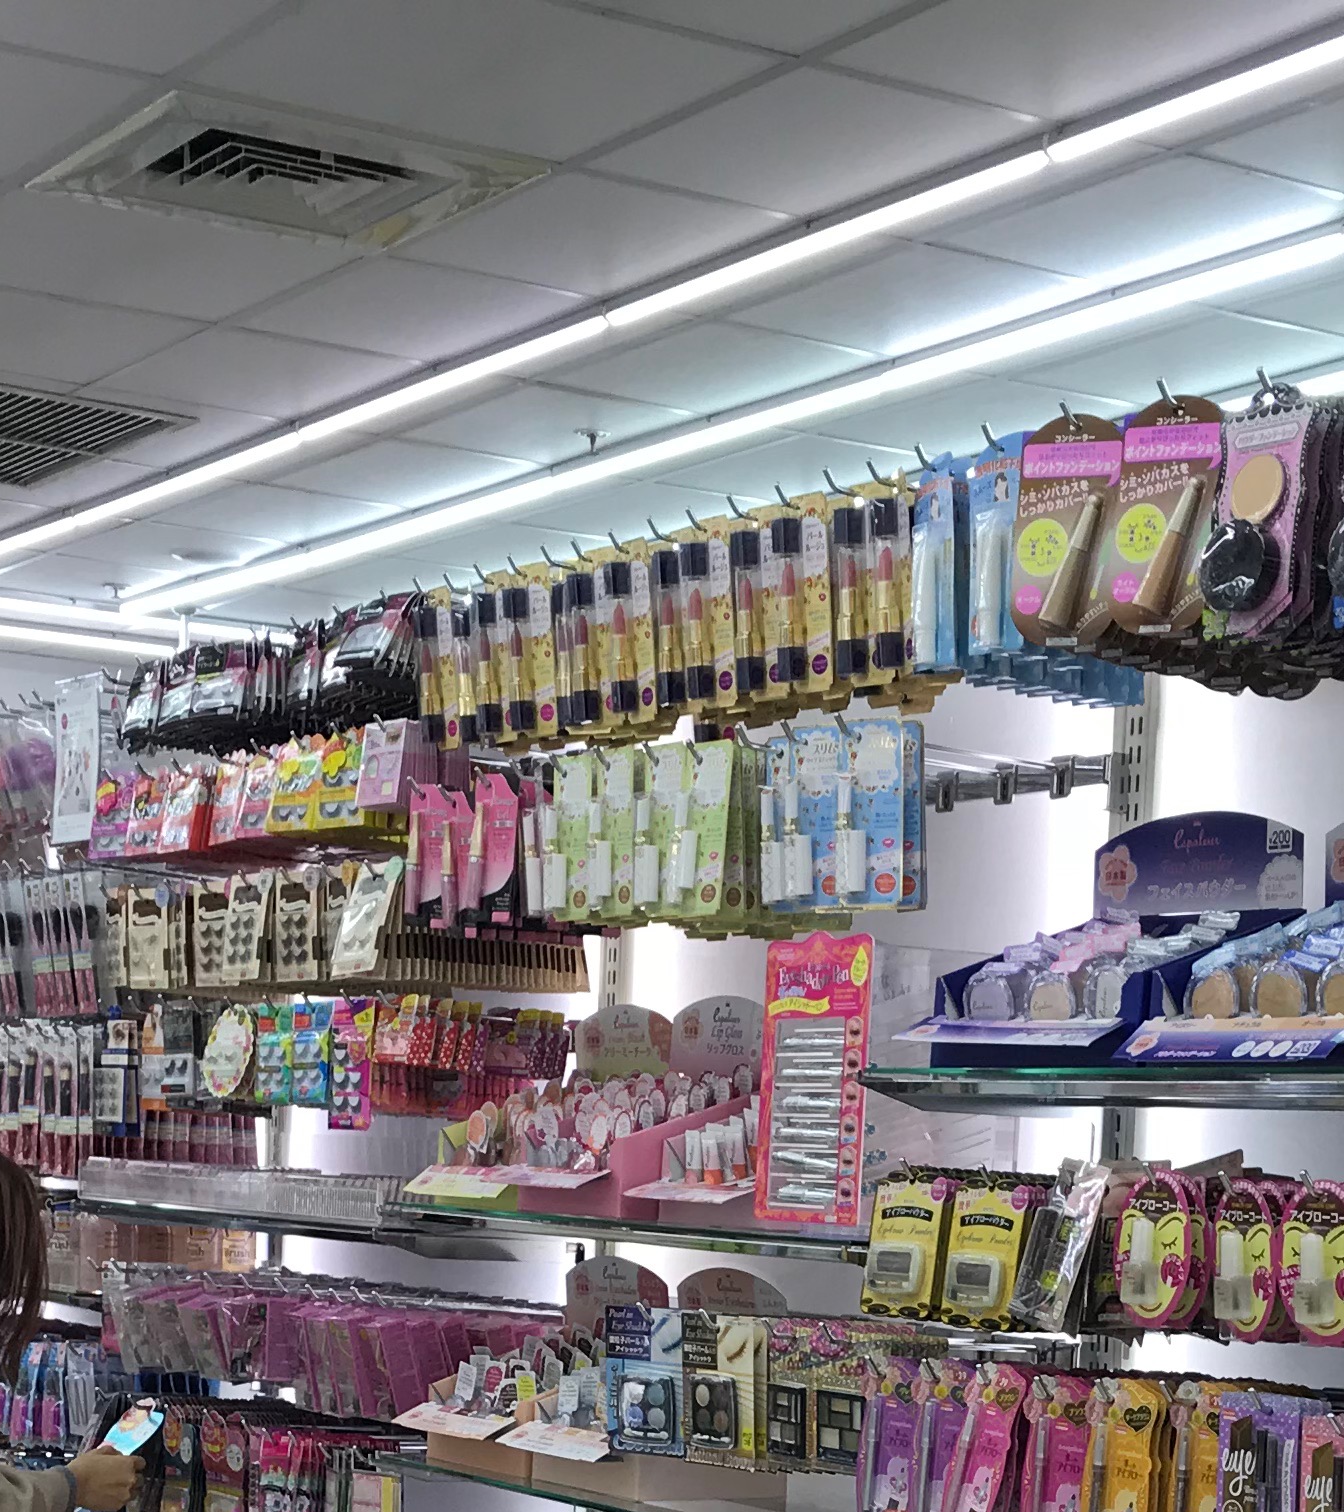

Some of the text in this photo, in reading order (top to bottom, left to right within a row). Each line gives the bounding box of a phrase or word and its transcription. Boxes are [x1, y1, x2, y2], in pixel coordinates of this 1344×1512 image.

[1157, 416, 1198, 425] コンシーラー
[1055, 434, 1095, 442] コンシーラー
[1146, 880, 1247, 899] フェイスパウダー
[1128, 1198, 1183, 1213] アイブローコート
[1219, 1208, 1267, 1223] アイブローコート
[1221, 1448, 1255, 1496] eye
